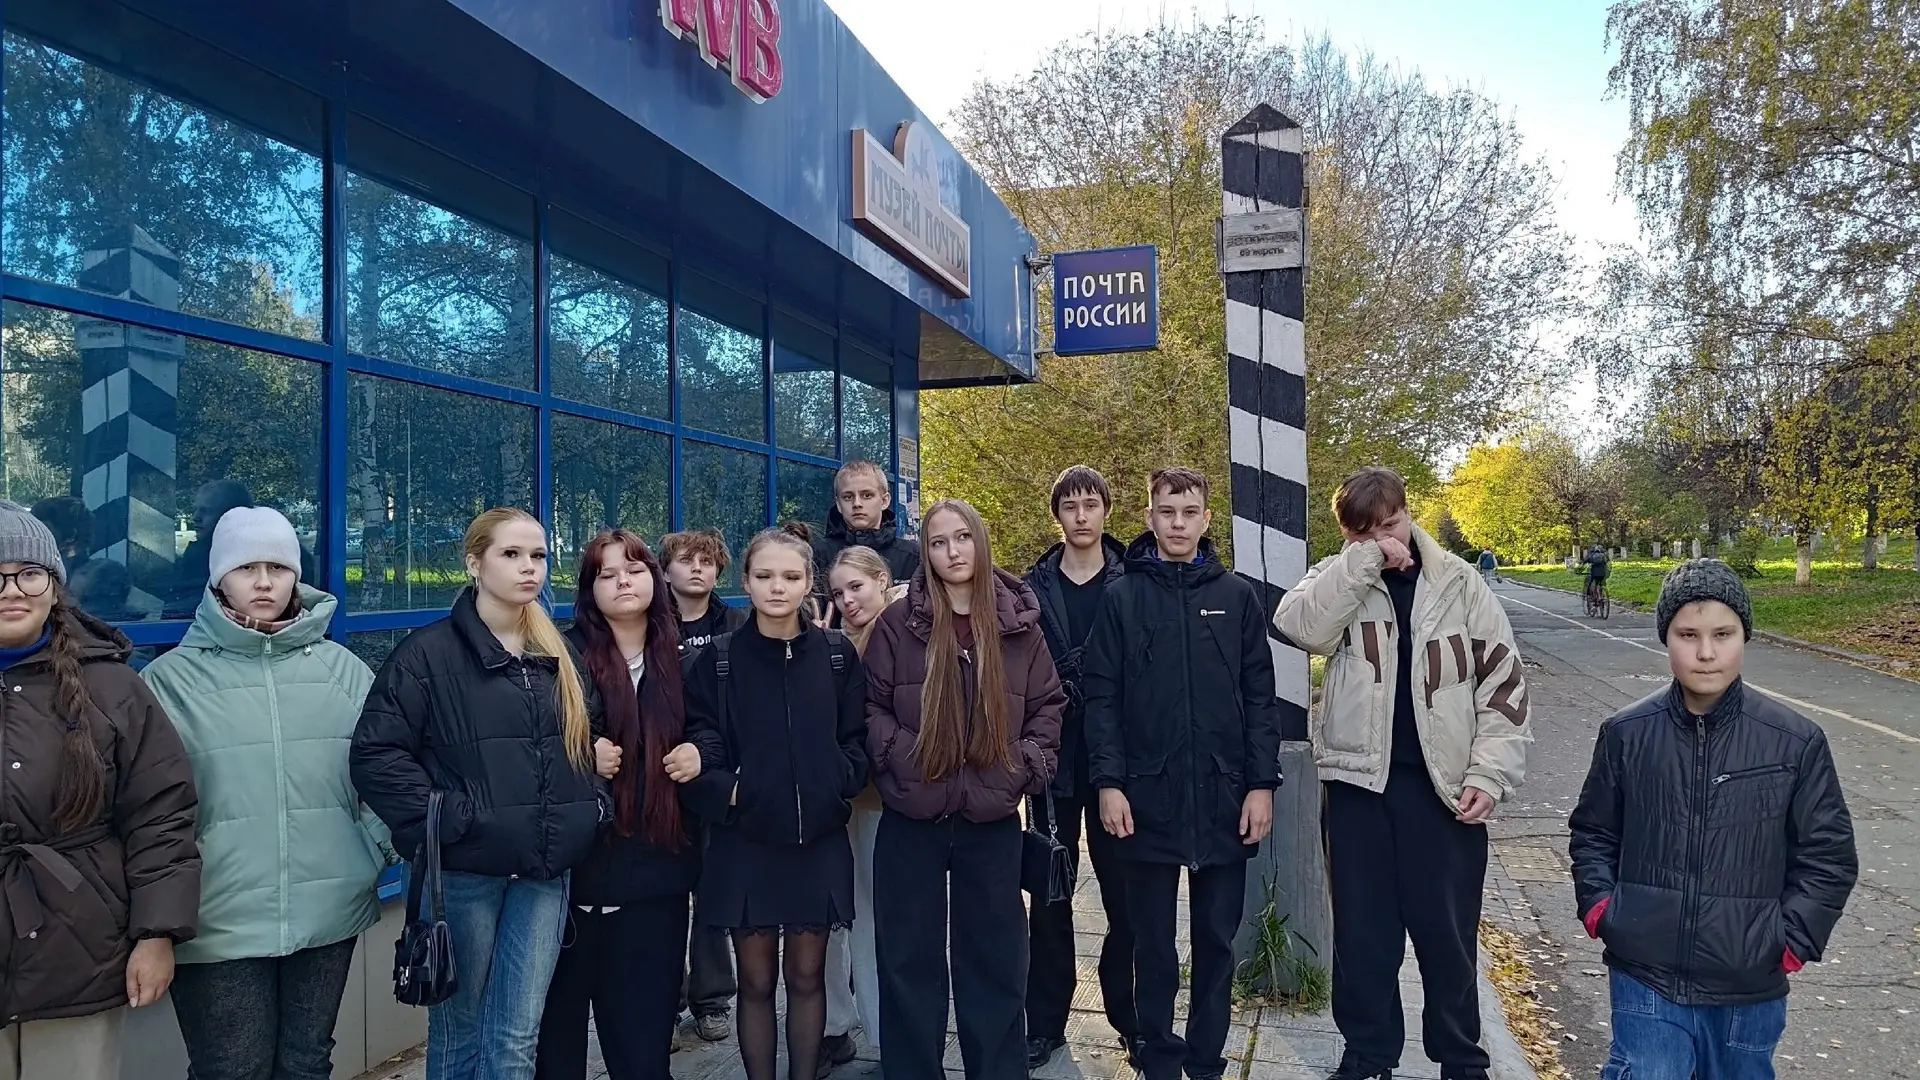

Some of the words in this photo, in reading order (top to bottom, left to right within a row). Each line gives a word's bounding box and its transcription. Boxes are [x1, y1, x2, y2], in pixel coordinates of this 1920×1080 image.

[870, 159, 921, 239] МУЗЕЙ
[924, 207, 966, 275] ПОЧТЫ
[1063, 271, 1145, 299] ПОЧТА
[1064, 301, 1146, 330] РОССИИ
